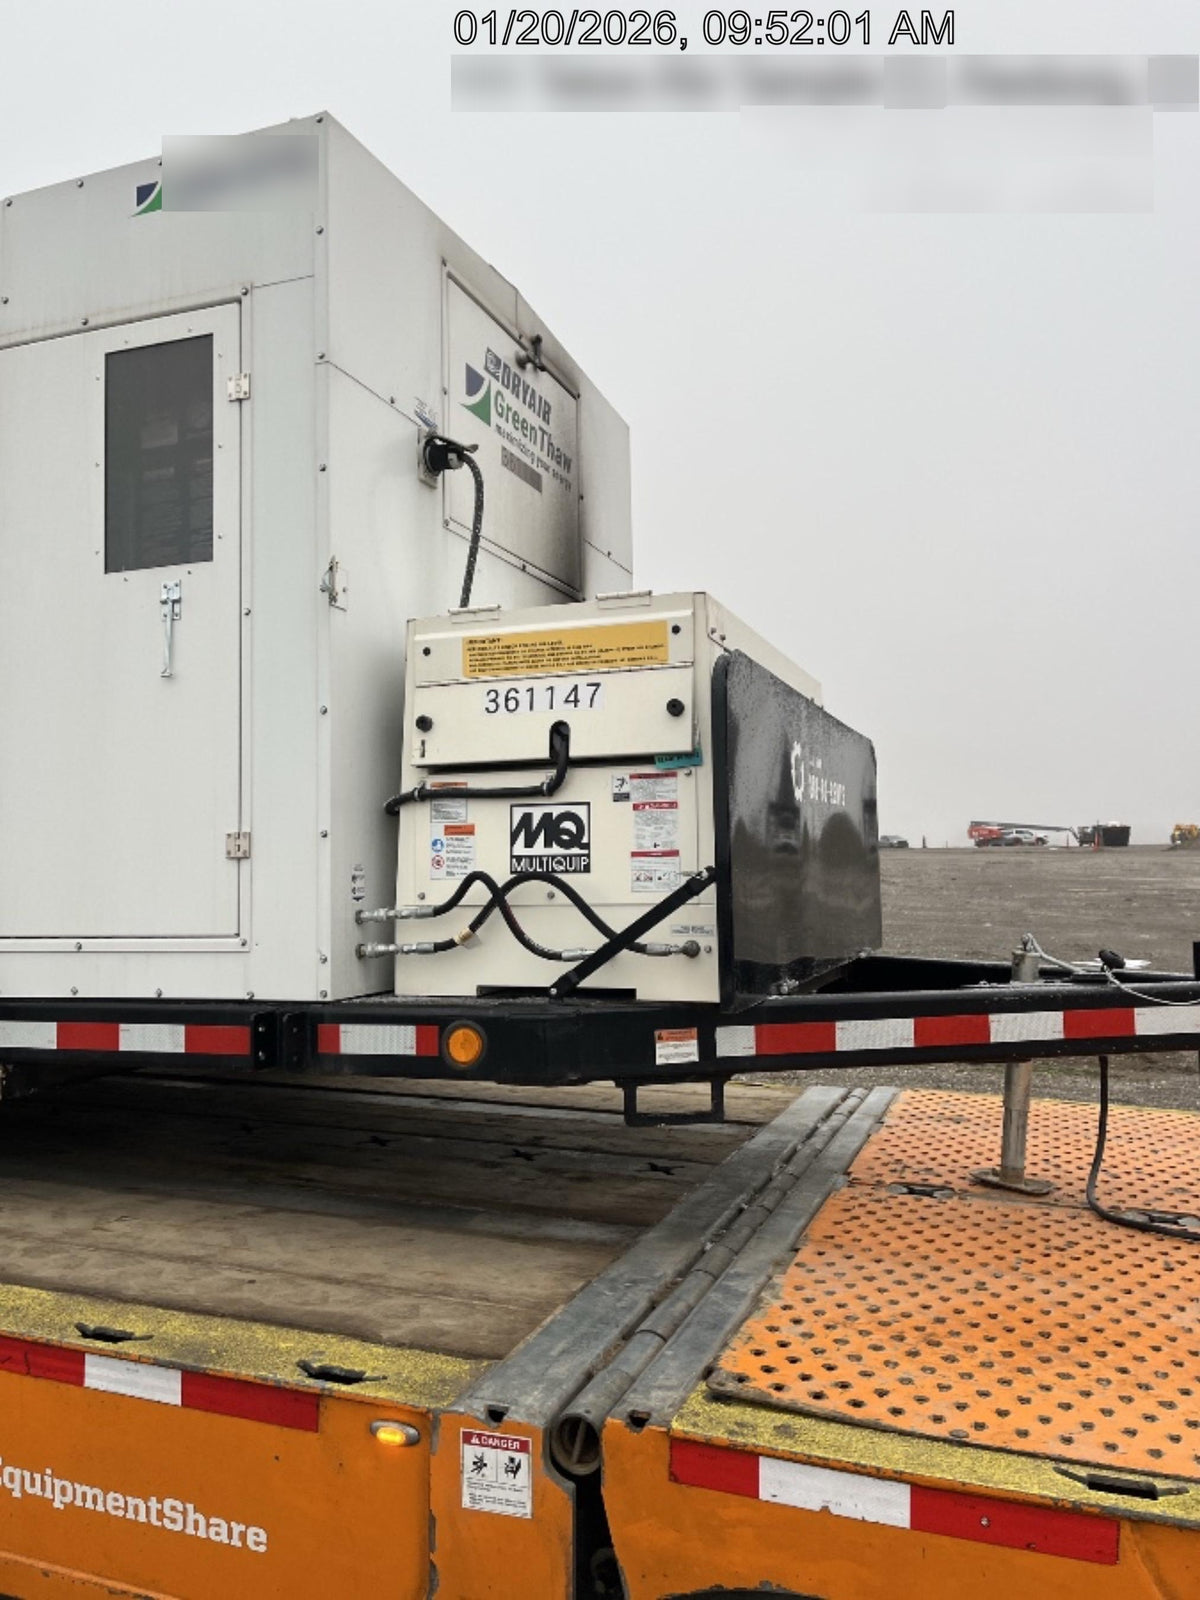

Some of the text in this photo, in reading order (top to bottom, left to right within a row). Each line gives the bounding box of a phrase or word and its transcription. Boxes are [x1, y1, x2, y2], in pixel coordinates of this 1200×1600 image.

[501, 362, 552, 426] DRYAIR
[494, 389, 573, 474] GreenThaw
[485, 682, 601, 714] 361147
[511, 811, 589, 850] MQ
[511, 856, 590, 873] MULTIQUIP
[0, 1456, 268, 1553] quipmentShare
